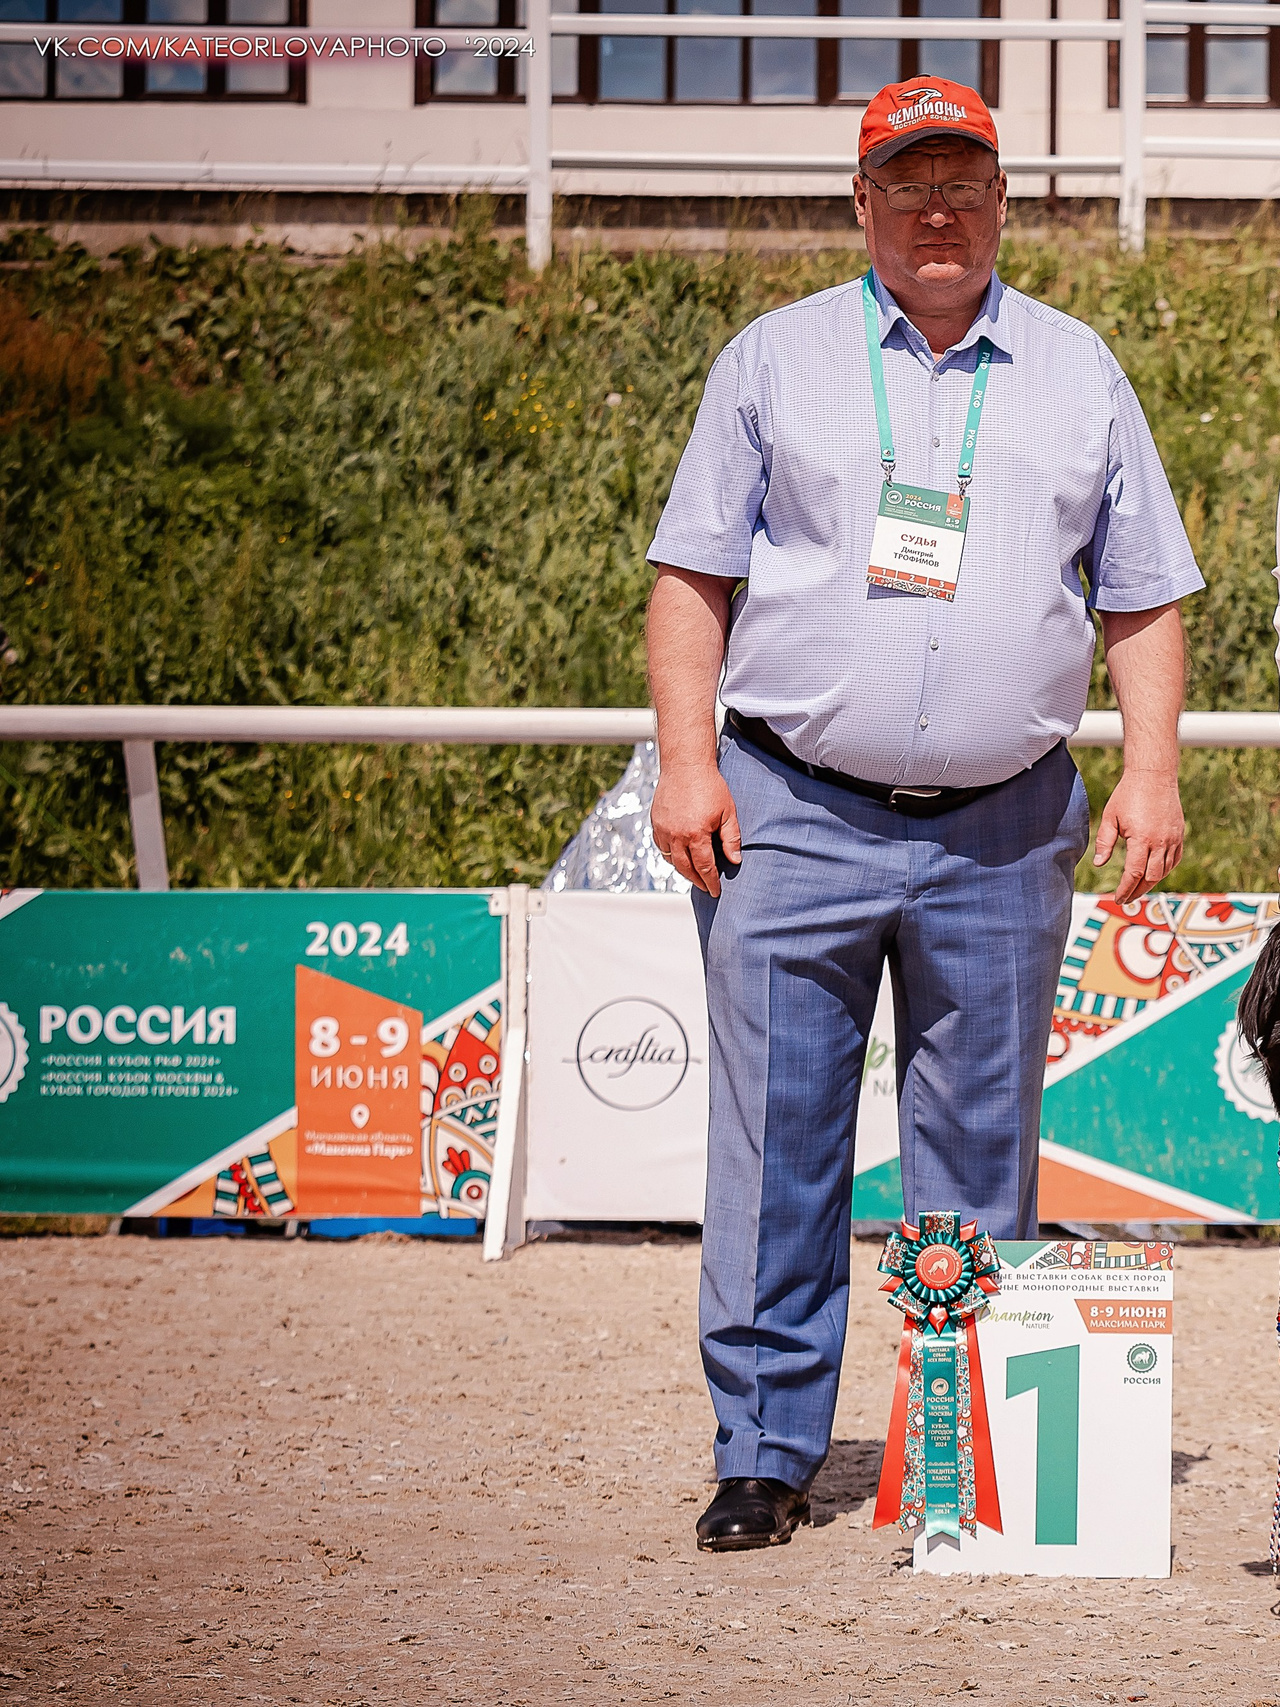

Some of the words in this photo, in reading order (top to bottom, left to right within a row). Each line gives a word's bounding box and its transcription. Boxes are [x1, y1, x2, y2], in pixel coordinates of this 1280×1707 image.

[887, 101, 968, 126] ЧЕМПИОНЫ
[893, 115, 927, 131] ВОСТОКА
[980, 351, 991, 370] РКФ
[973, 389, 983, 409] РКФ
[965, 429, 976, 449] РКФ
[905, 499, 942, 512] РОССИЯ
[901, 534, 937, 548] СУДЬЯ
[893, 552, 940, 568] ТРОФИМОВ
[901, 546, 934, 559] Дмитрий
[304, 921, 410, 957] 2024
[39, 1004, 237, 1045] РОССИЯ
[578, 1022, 686, 1079] craftia
[310, 1064, 409, 1090] ИЮНЯ
[1016, 1273, 1067, 1281] ВЫСТАВКИ
[1071, 1273, 1102, 1281] СОБАК
[1134, 1274, 1166, 1282] ПОРОД
[1022, 1284, 1105, 1292] МОНОПОРОДНЫЕ
[979, 1304, 1054, 1327] Champion
[1090, 1306, 1114, 1318] 8-9
[1119, 1306, 1167, 1318] ИЮНЯ
[1090, 1320, 1139, 1328] МАКСИМА
[1141, 1320, 1166, 1329] ПАРК
[1123, 1377, 1161, 1385] РОССИЯ
[1006, 1344, 1080, 1546] 1
